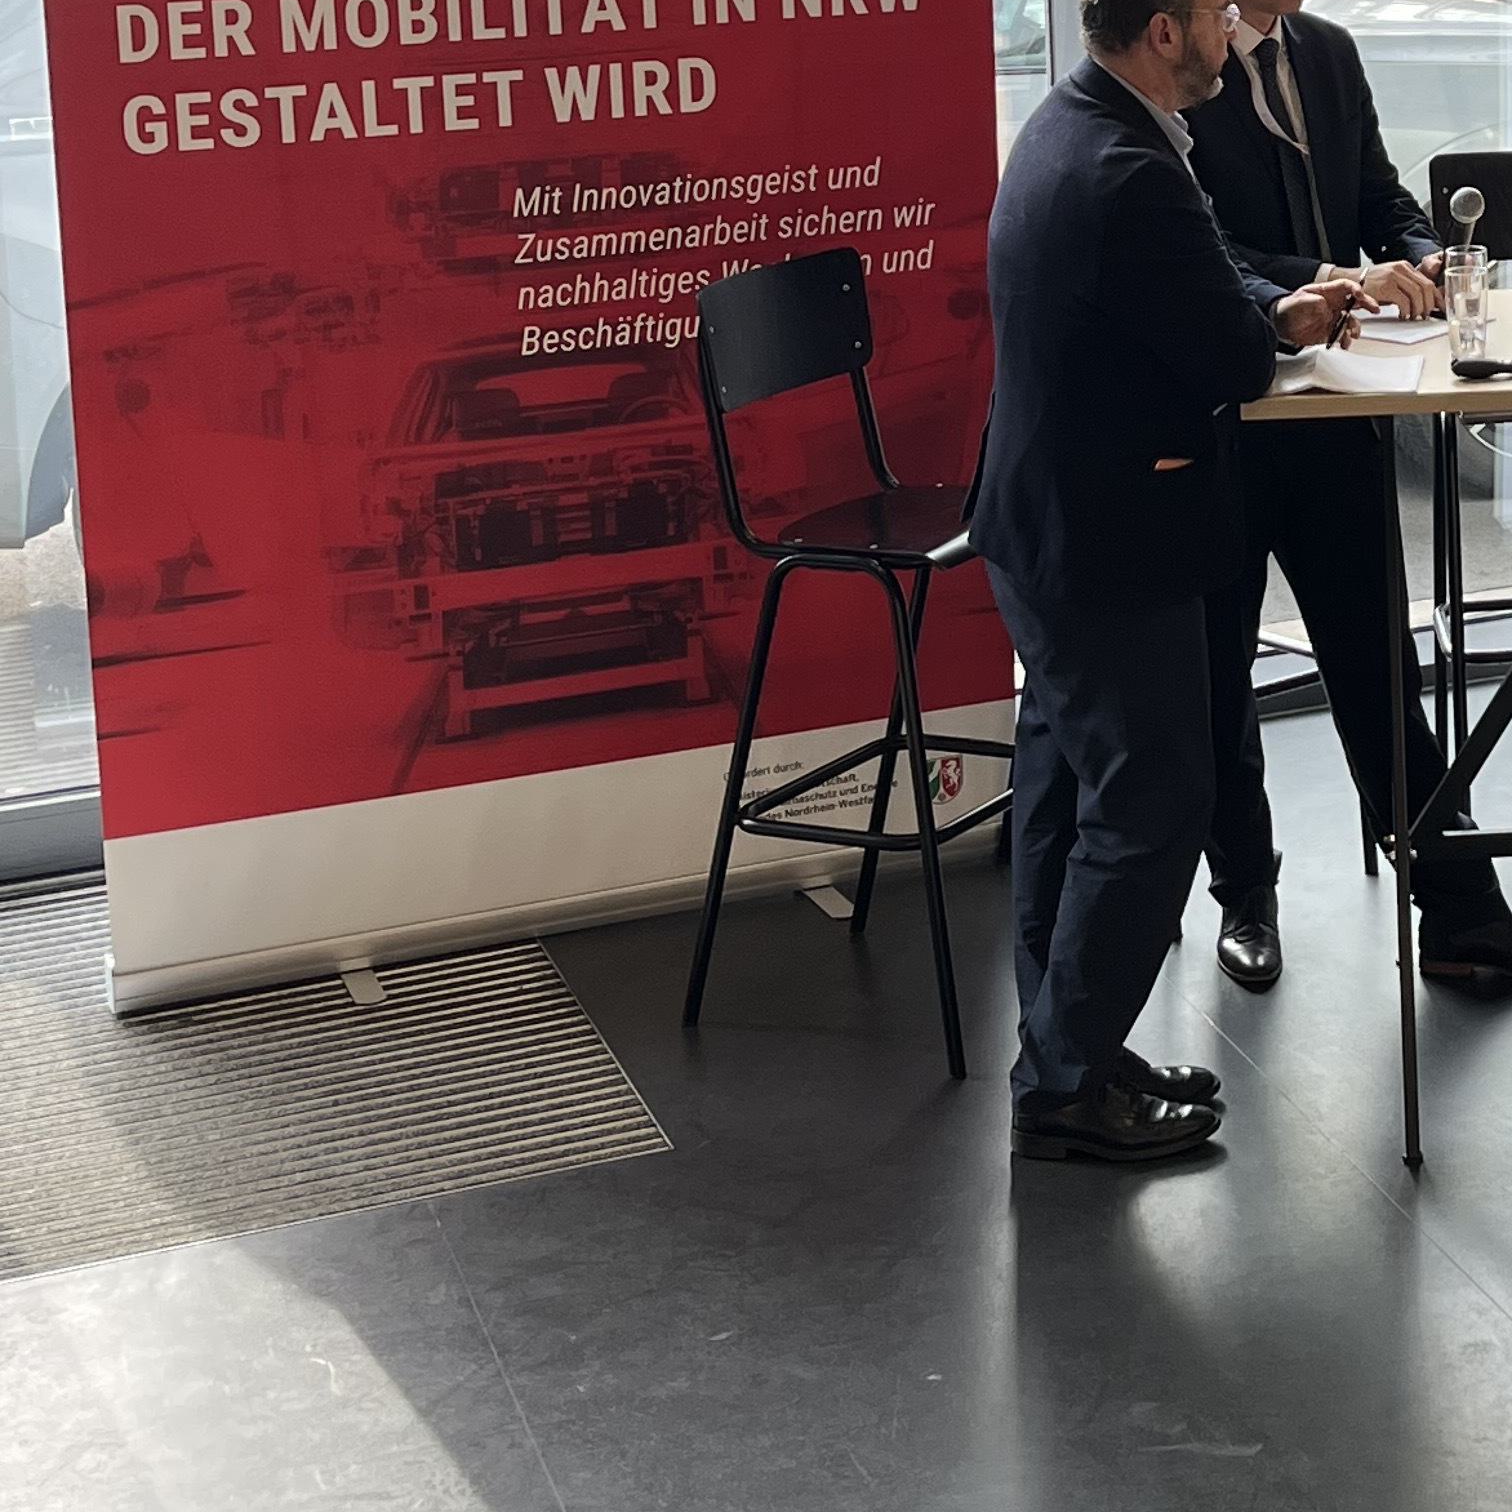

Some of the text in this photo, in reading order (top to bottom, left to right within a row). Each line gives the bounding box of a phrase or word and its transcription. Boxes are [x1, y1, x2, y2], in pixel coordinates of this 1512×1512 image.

[122, 57, 718, 155] GESTALTET WIRD
[513, 156, 881, 218] Mit Innovationsgeist und
[514, 199, 936, 265] Zusammenarbeit sichern wir
[518, 267, 710, 311] nachhaltiges
[882, 240, 935, 273] und
[520, 311, 699, 356] Beschäftigu
